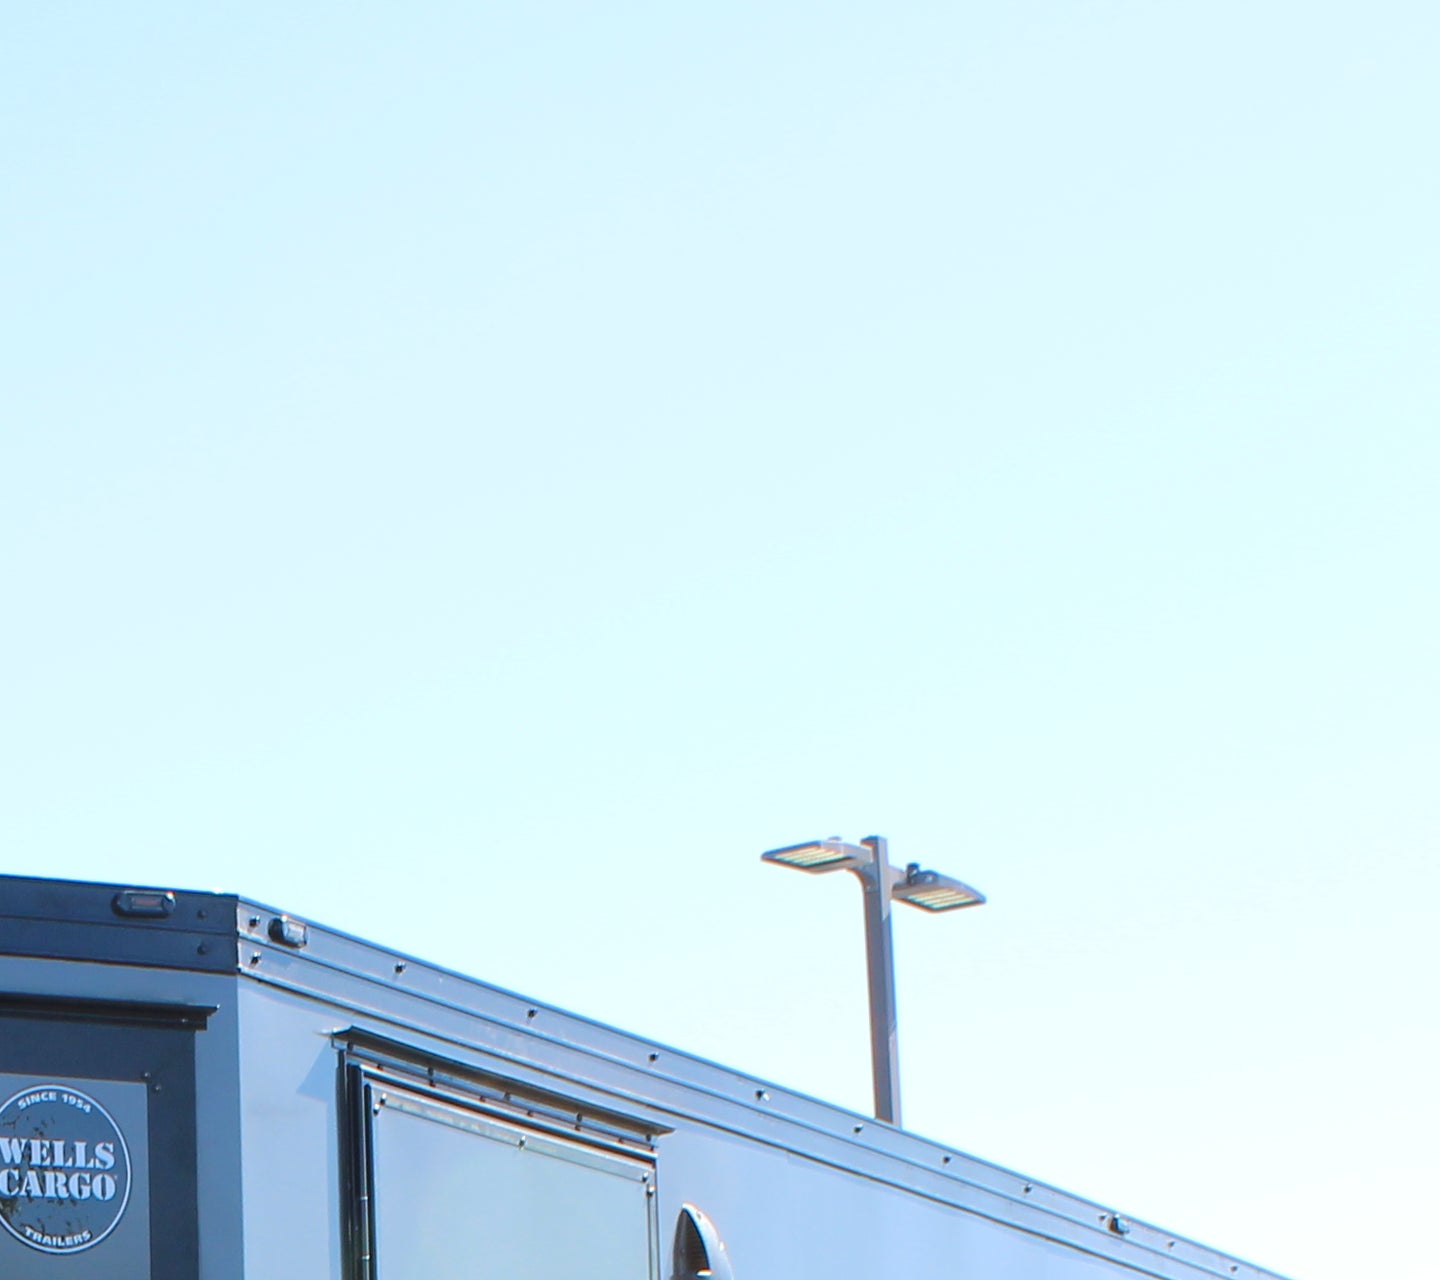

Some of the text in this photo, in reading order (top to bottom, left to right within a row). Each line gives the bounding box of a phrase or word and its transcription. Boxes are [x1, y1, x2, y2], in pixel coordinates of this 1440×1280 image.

[17, 1091, 93, 1113] SINCE 1954
[24, 1225, 92, 1247] TRAILERS
